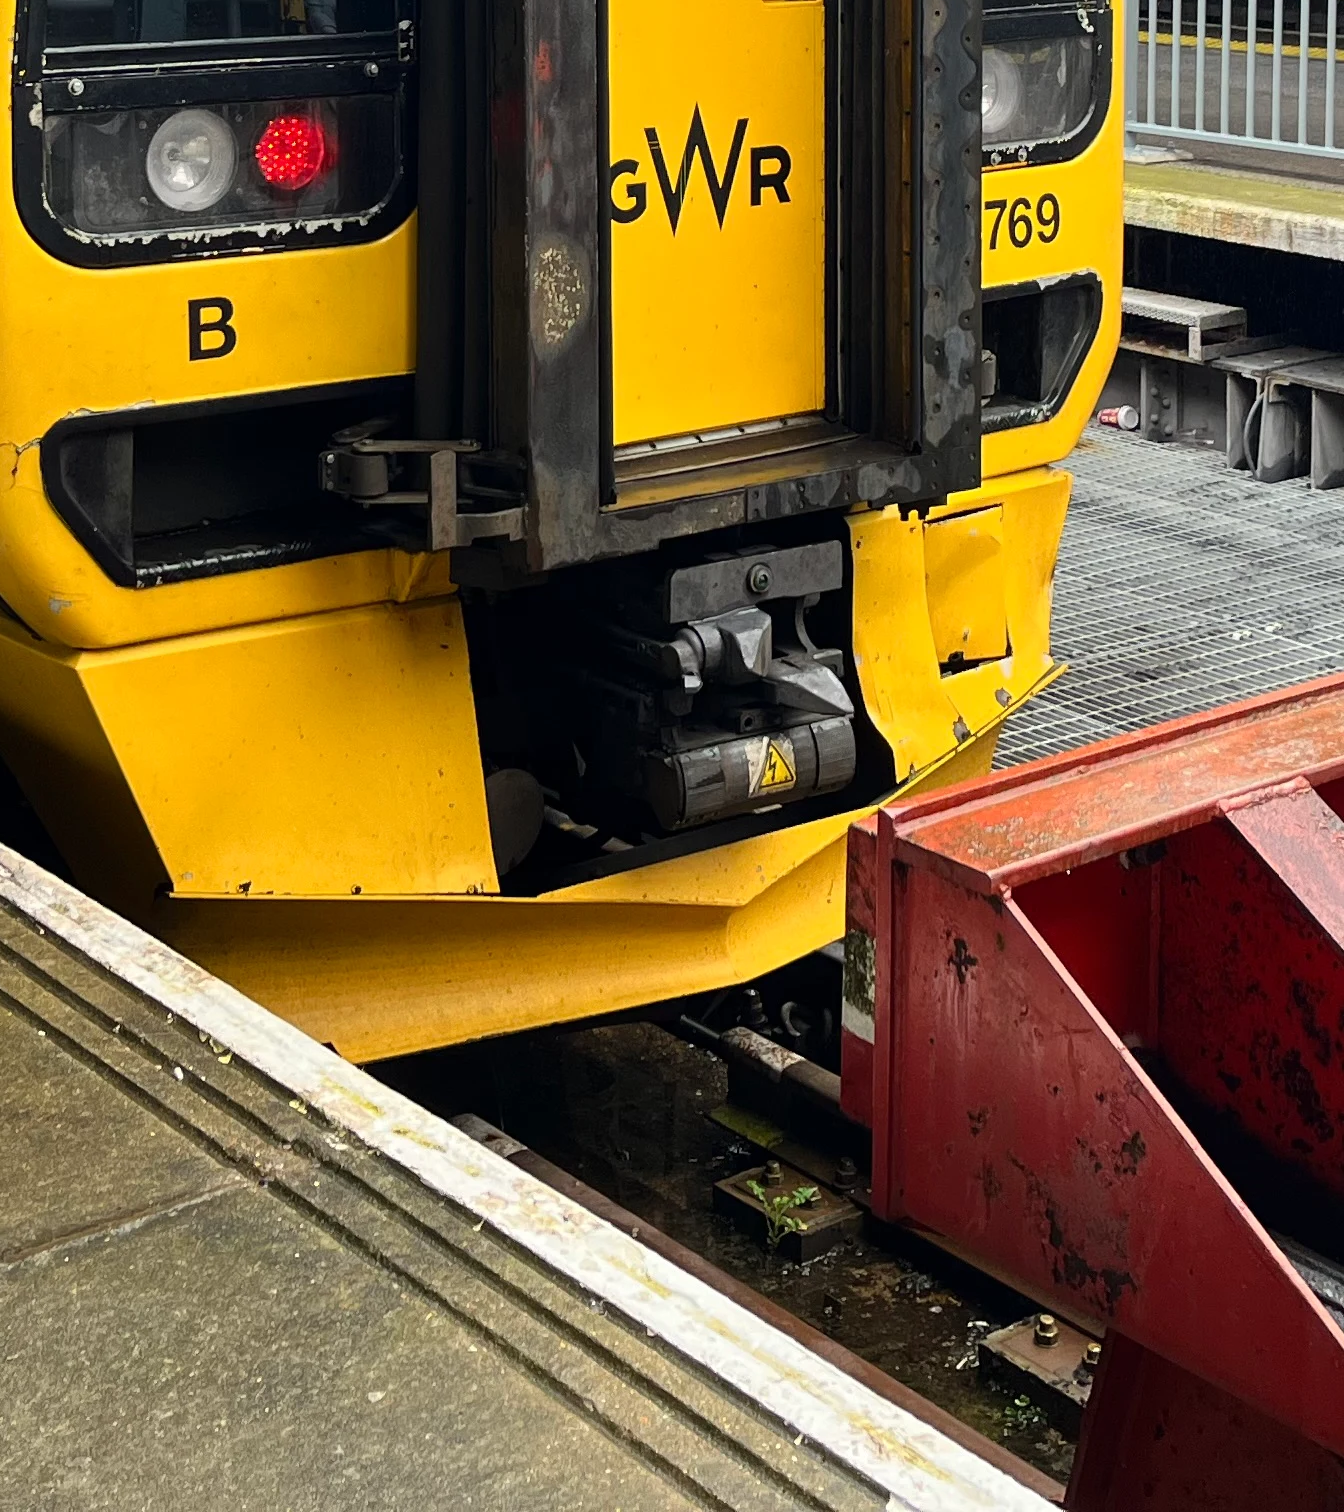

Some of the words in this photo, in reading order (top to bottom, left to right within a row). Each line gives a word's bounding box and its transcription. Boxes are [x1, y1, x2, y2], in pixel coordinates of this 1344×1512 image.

[609, 101, 792, 238] GWR
[984, 193, 1060, 251] 769
[188, 297, 236, 361] B
